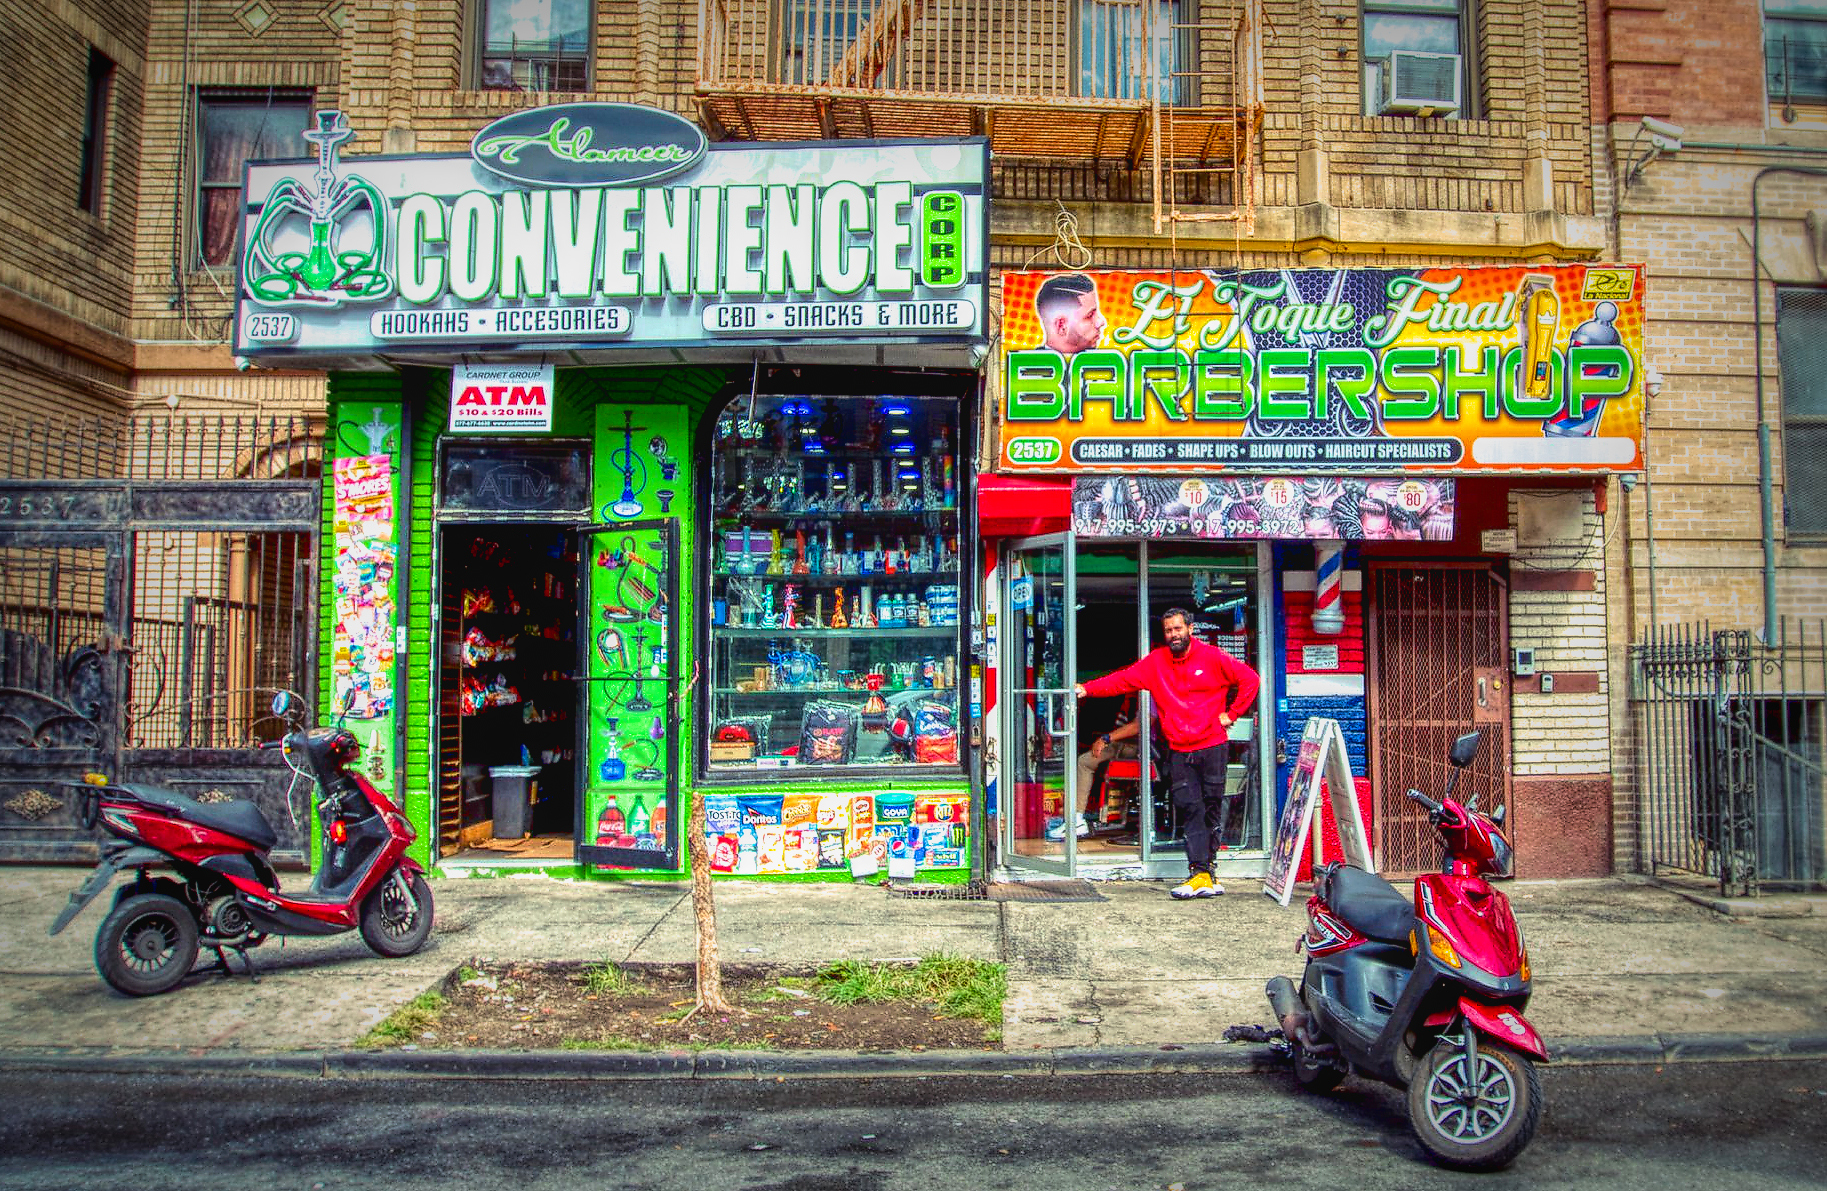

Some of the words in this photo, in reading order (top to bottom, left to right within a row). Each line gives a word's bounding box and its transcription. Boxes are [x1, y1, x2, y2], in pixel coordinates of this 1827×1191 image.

[396, 180, 913, 304] CONVENIENCE
[930, 196, 957, 283] CORP
[381, 311, 470, 335] HOOKAHS
[495, 308, 619, 332] ACCESORIES
[717, 306, 757, 328] CBD
[784, 305, 863, 327] SNACKS
[878, 305, 890, 326] &
[899, 303, 958, 326] MORE
[1113, 279, 1204, 351] El
[1199, 279, 1355, 351] Toque
[1362, 274, 1517, 348] Final
[250, 315, 290, 338] 2537
[466, 371, 508, 379] CARDNET
[508, 371, 541, 379] GROUP
[1006, 345, 1634, 421] BARBERSHOP
[456, 385, 547, 406] ATM
[458, 408, 479, 416] $10
[491, 408, 515, 416] $20
[516, 408, 543, 416] Bills
[1013, 442, 1054, 459] 2537
[1079, 443, 1124, 459] CAESAR
[1131, 443, 1167, 459] FADES
[1177, 443, 1214, 459] SHAPE
[1215, 443, 1239, 459] UPS
[1249, 443, 1284, 459] BLOW
[1285, 443, 1316, 459] OUTS
[1325, 443, 1376, 459] HAIRCUT
[1377, 443, 1451, 459] SPECIALISTS
[476, 474, 552, 498] ATM
[1075, 519, 1177, 534] 917-995-3973
[1193, 519, 1299, 535] 917-995-3972
[1497, 1012, 1526, 1036] 150
